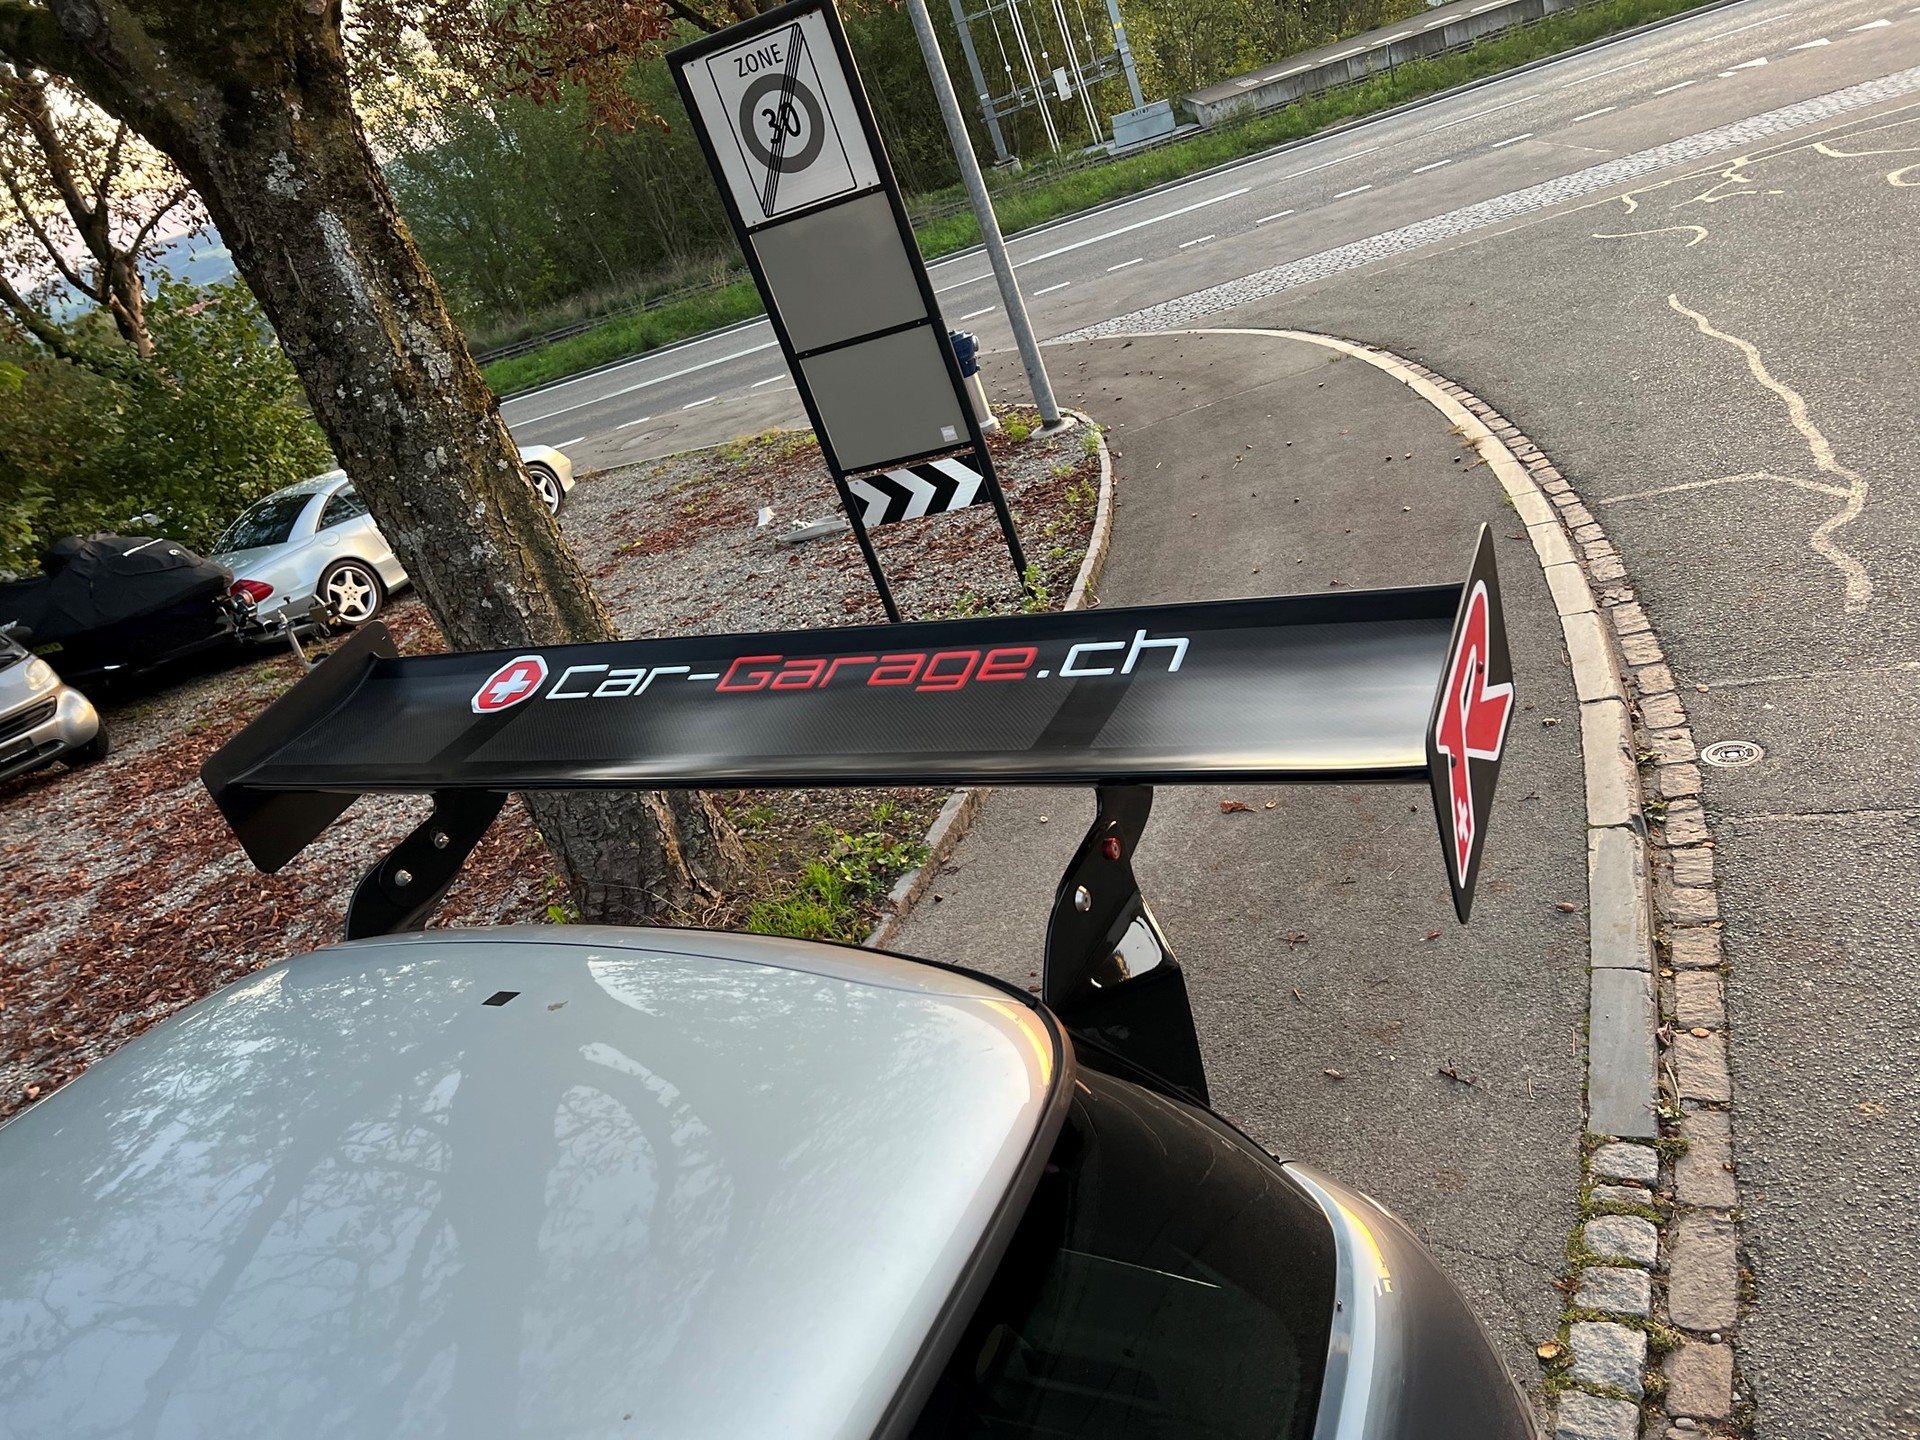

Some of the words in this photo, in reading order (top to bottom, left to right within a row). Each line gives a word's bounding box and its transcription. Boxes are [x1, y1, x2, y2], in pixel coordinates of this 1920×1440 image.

[733, 43, 784, 78] ZONE
[761, 102, 802, 144] 30
[545, 629, 1190, 700] Car-Garage.ch
